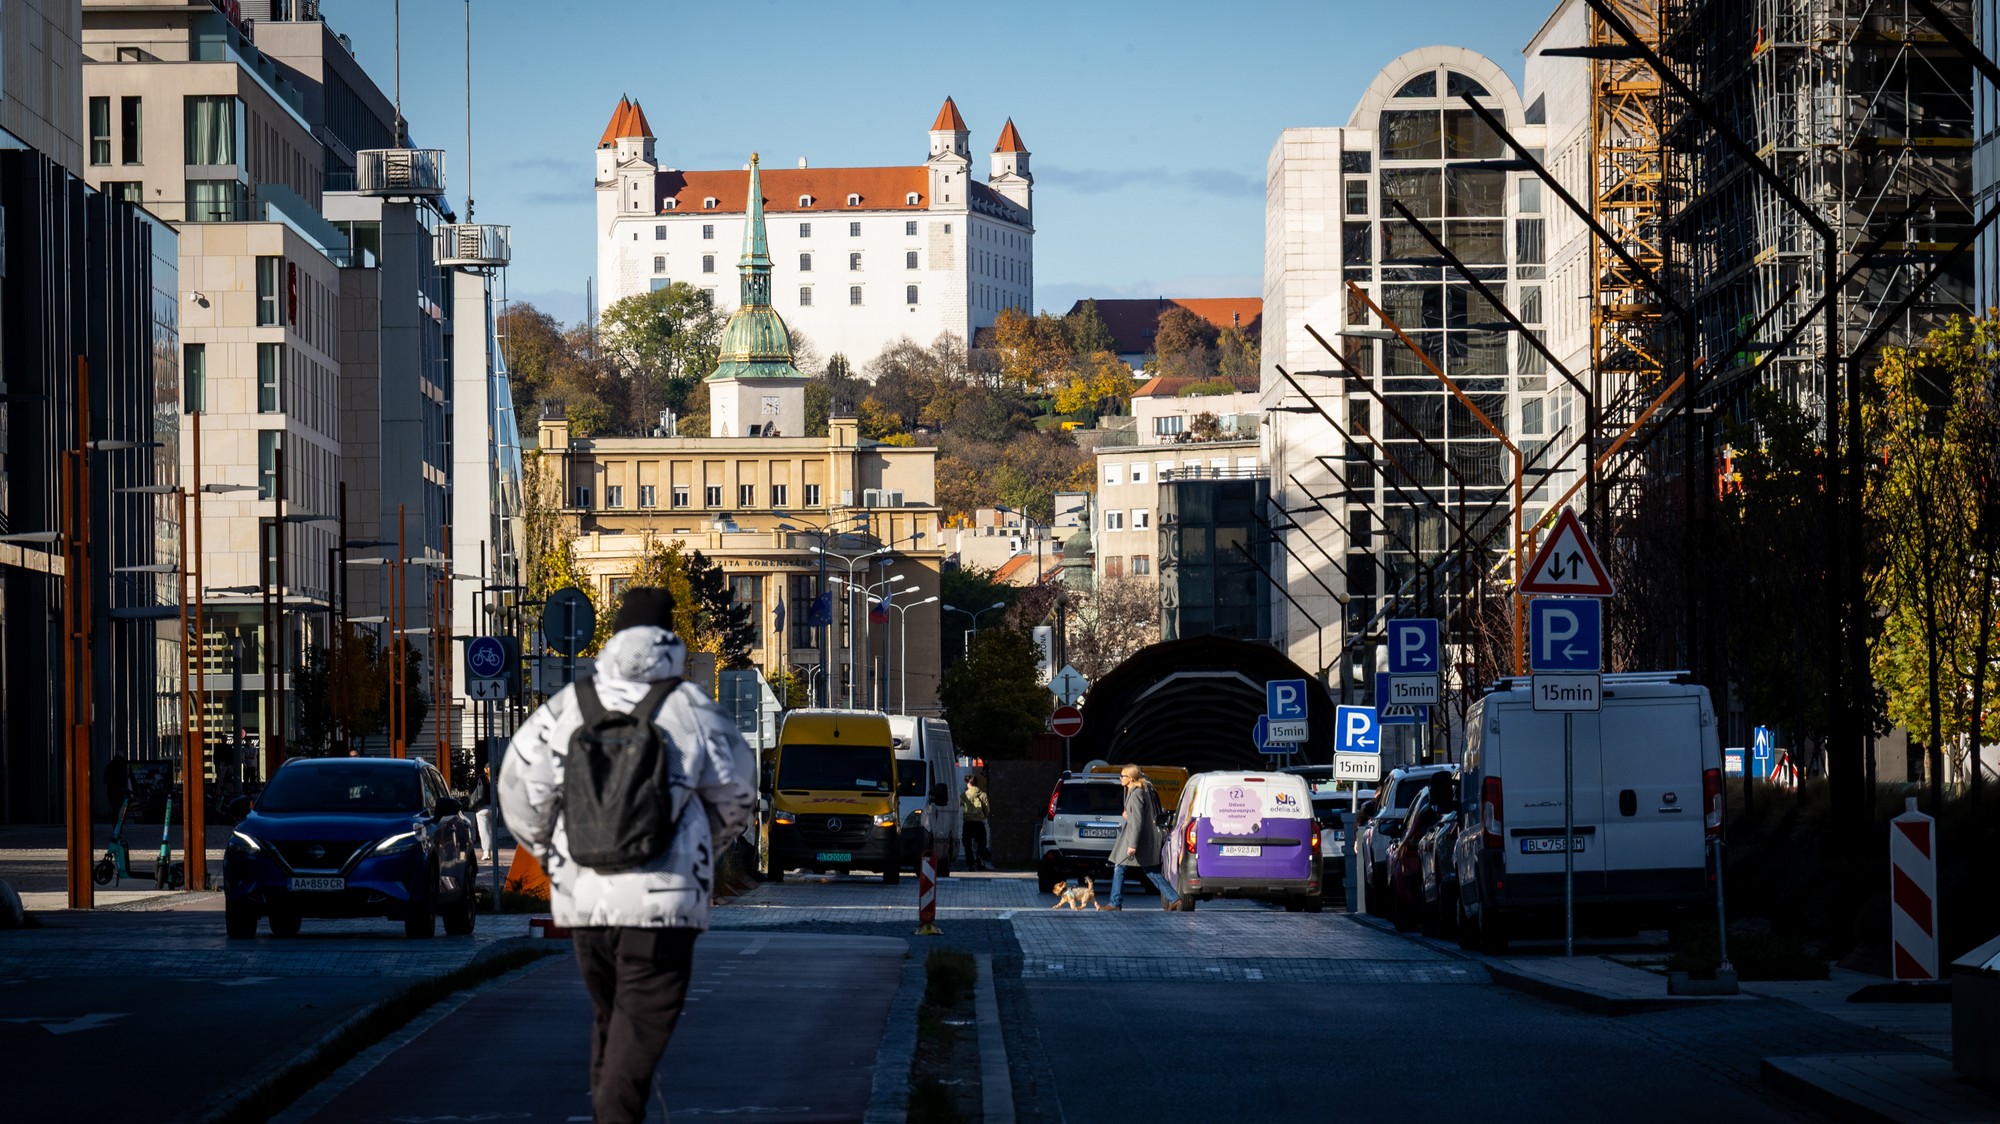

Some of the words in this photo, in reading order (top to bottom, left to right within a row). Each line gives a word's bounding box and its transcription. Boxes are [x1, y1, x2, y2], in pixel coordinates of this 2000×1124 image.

[1542, 608, 1579, 661] P
[1400, 626, 1426, 667] P
[1394, 682, 1434, 698] 15min
[1541, 684, 1592, 701] 15min
[1276, 685, 1297, 715] P
[1272, 726, 1304, 738] 15min
[1346, 712, 1371, 747] P
[1339, 761, 1375, 773] 15min
[1270, 805, 1300, 813] edelia.sk
